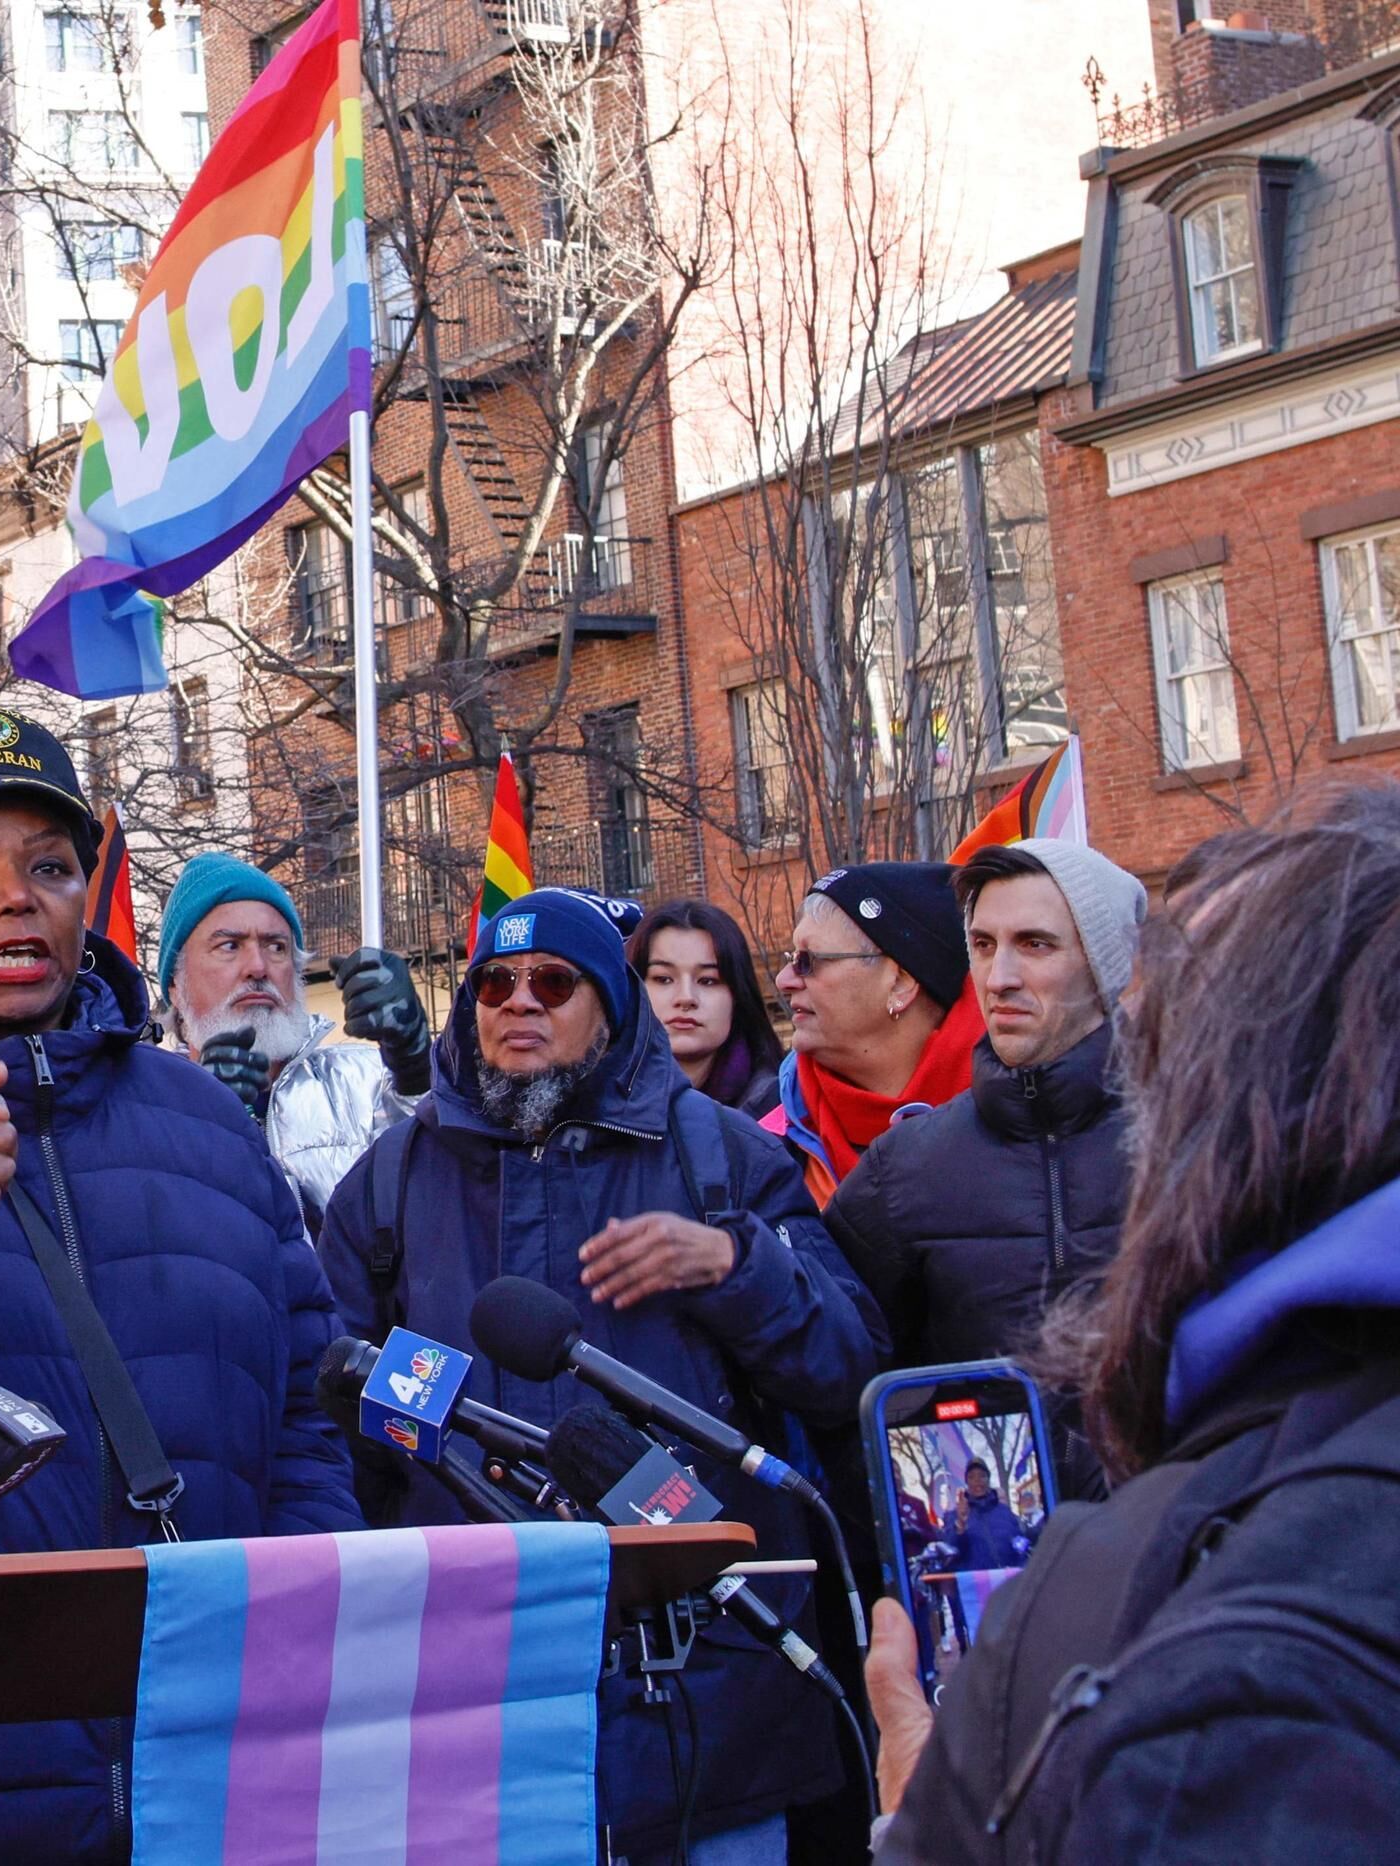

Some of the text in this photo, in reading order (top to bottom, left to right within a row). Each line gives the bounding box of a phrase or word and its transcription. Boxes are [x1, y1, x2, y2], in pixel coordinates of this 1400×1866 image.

[503, 917, 530, 929] NEW
[499, 924, 530, 937] YORK
[501, 934, 526, 946] LIFE
[388, 1372, 424, 1405] 4
[416, 1354, 449, 1410] NEW YORK
